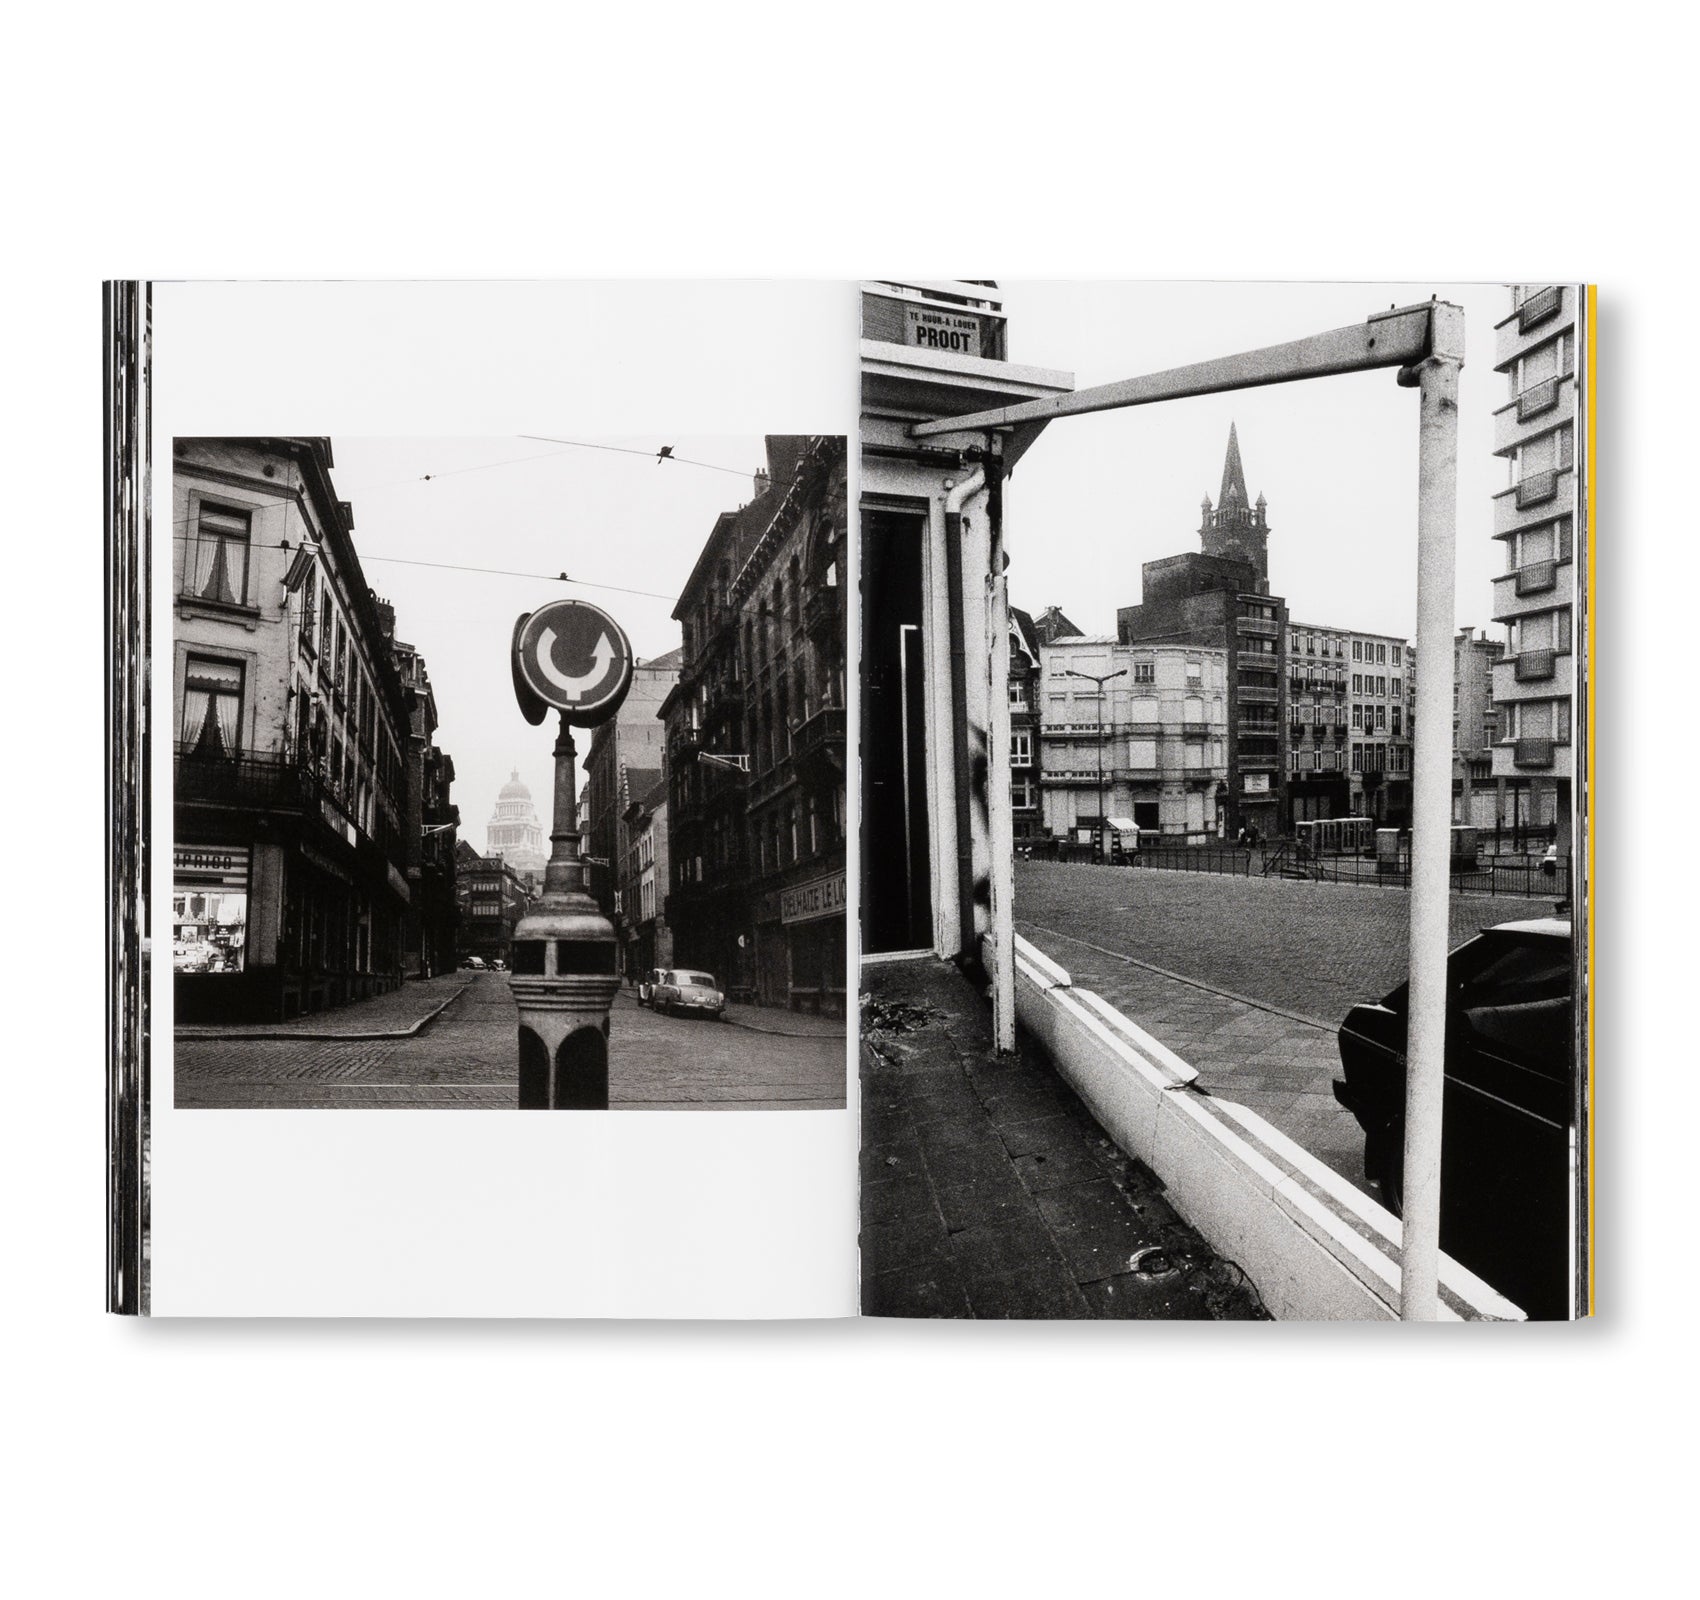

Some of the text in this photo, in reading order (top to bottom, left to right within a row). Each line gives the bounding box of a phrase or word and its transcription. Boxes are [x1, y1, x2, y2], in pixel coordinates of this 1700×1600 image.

[909, 312, 919, 321] TE
[953, 319, 976, 330] LOUER
[916, 325, 971, 352] PROOT
[822, 882, 832, 908] LE
